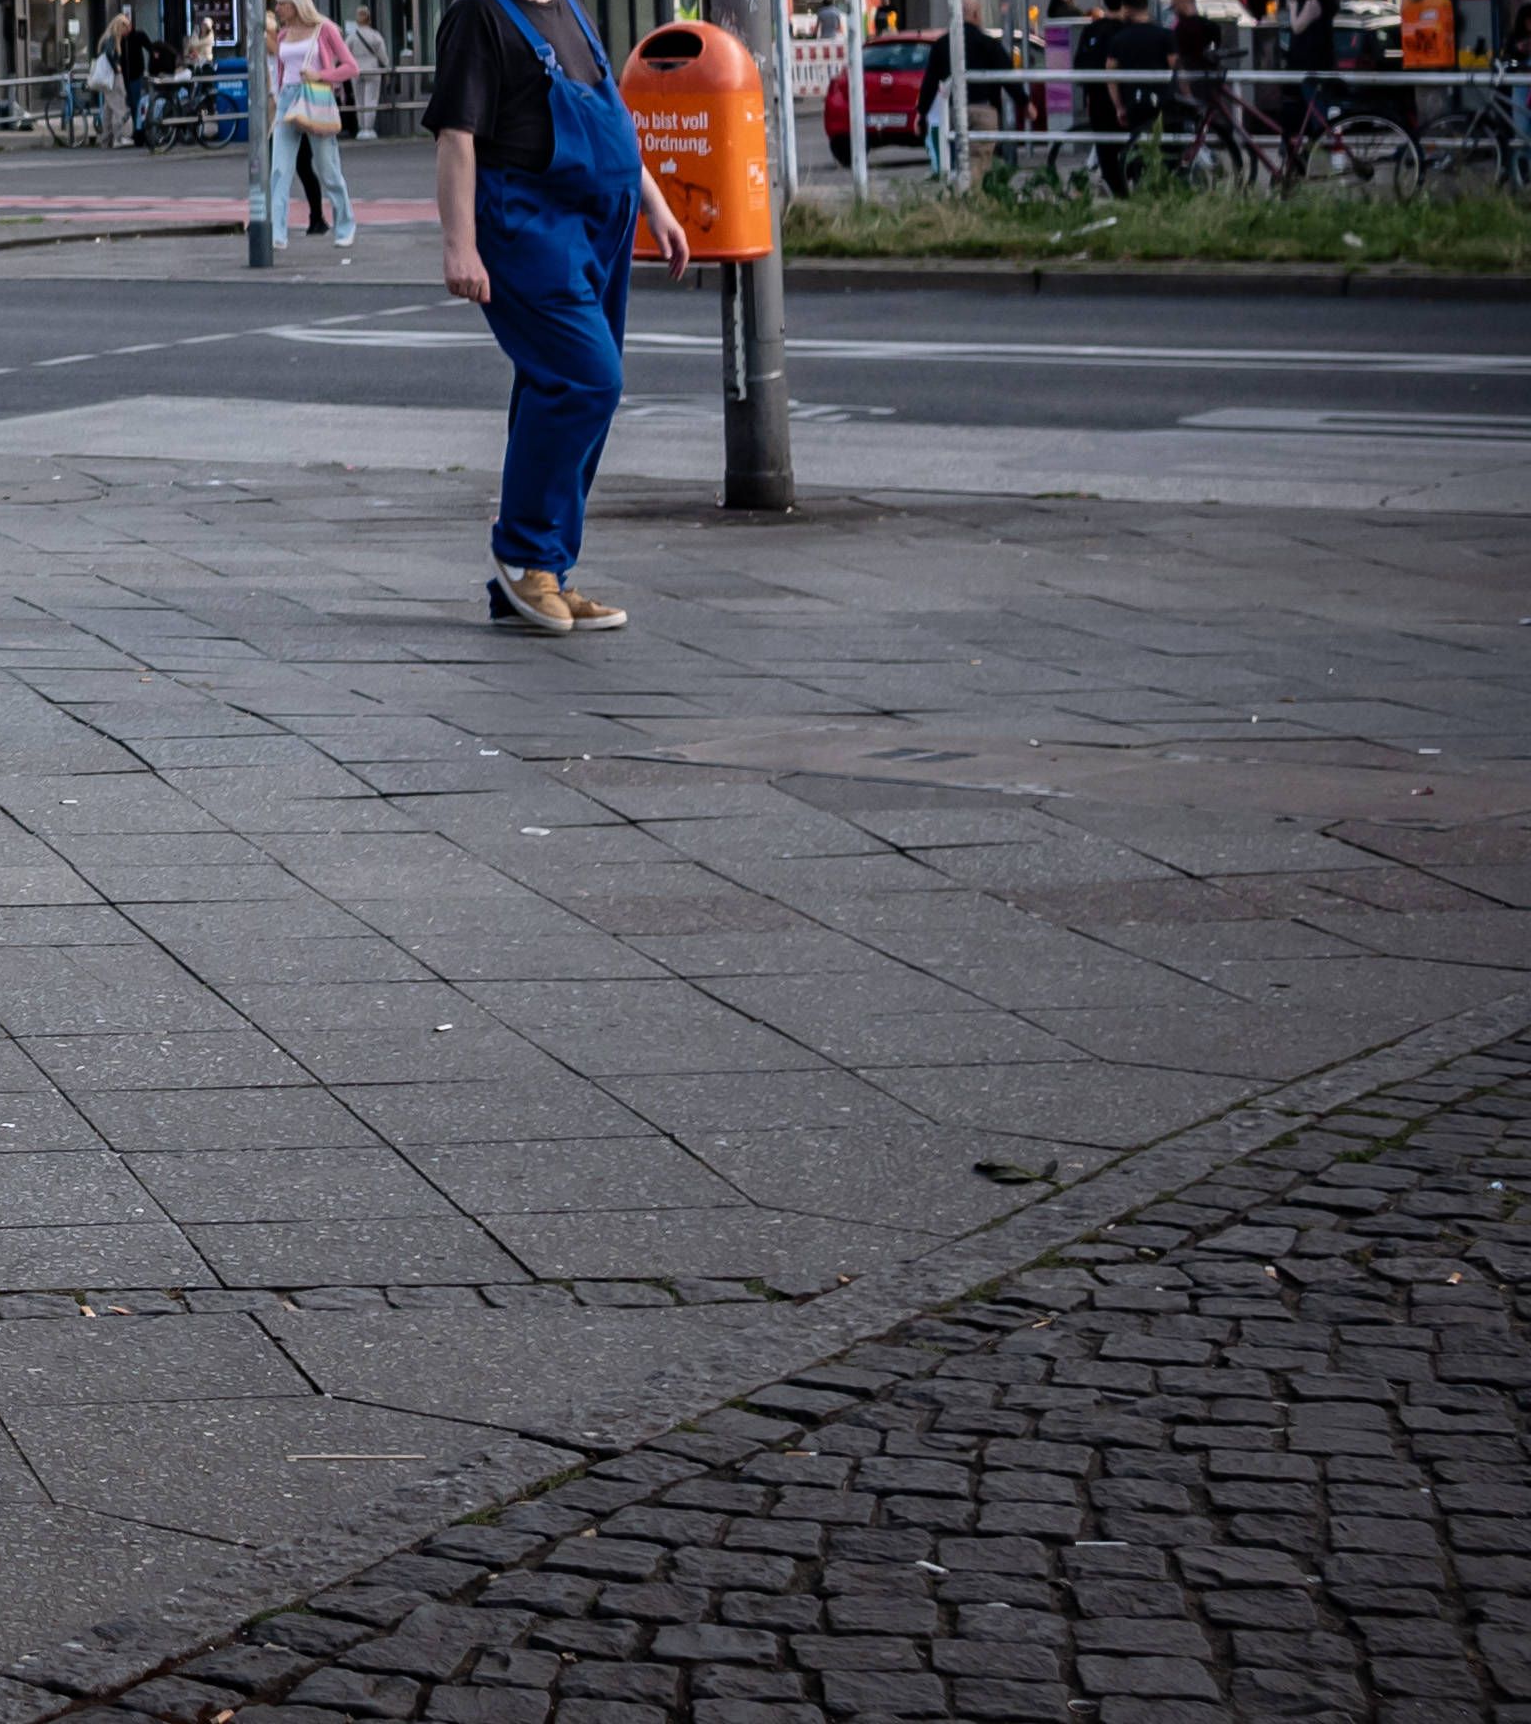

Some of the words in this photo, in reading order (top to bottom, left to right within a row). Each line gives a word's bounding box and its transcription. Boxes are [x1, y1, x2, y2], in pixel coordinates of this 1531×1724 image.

[633, 111, 649, 129] Du
[652, 111, 678, 129] bist
[681, 111, 708, 130] voll
